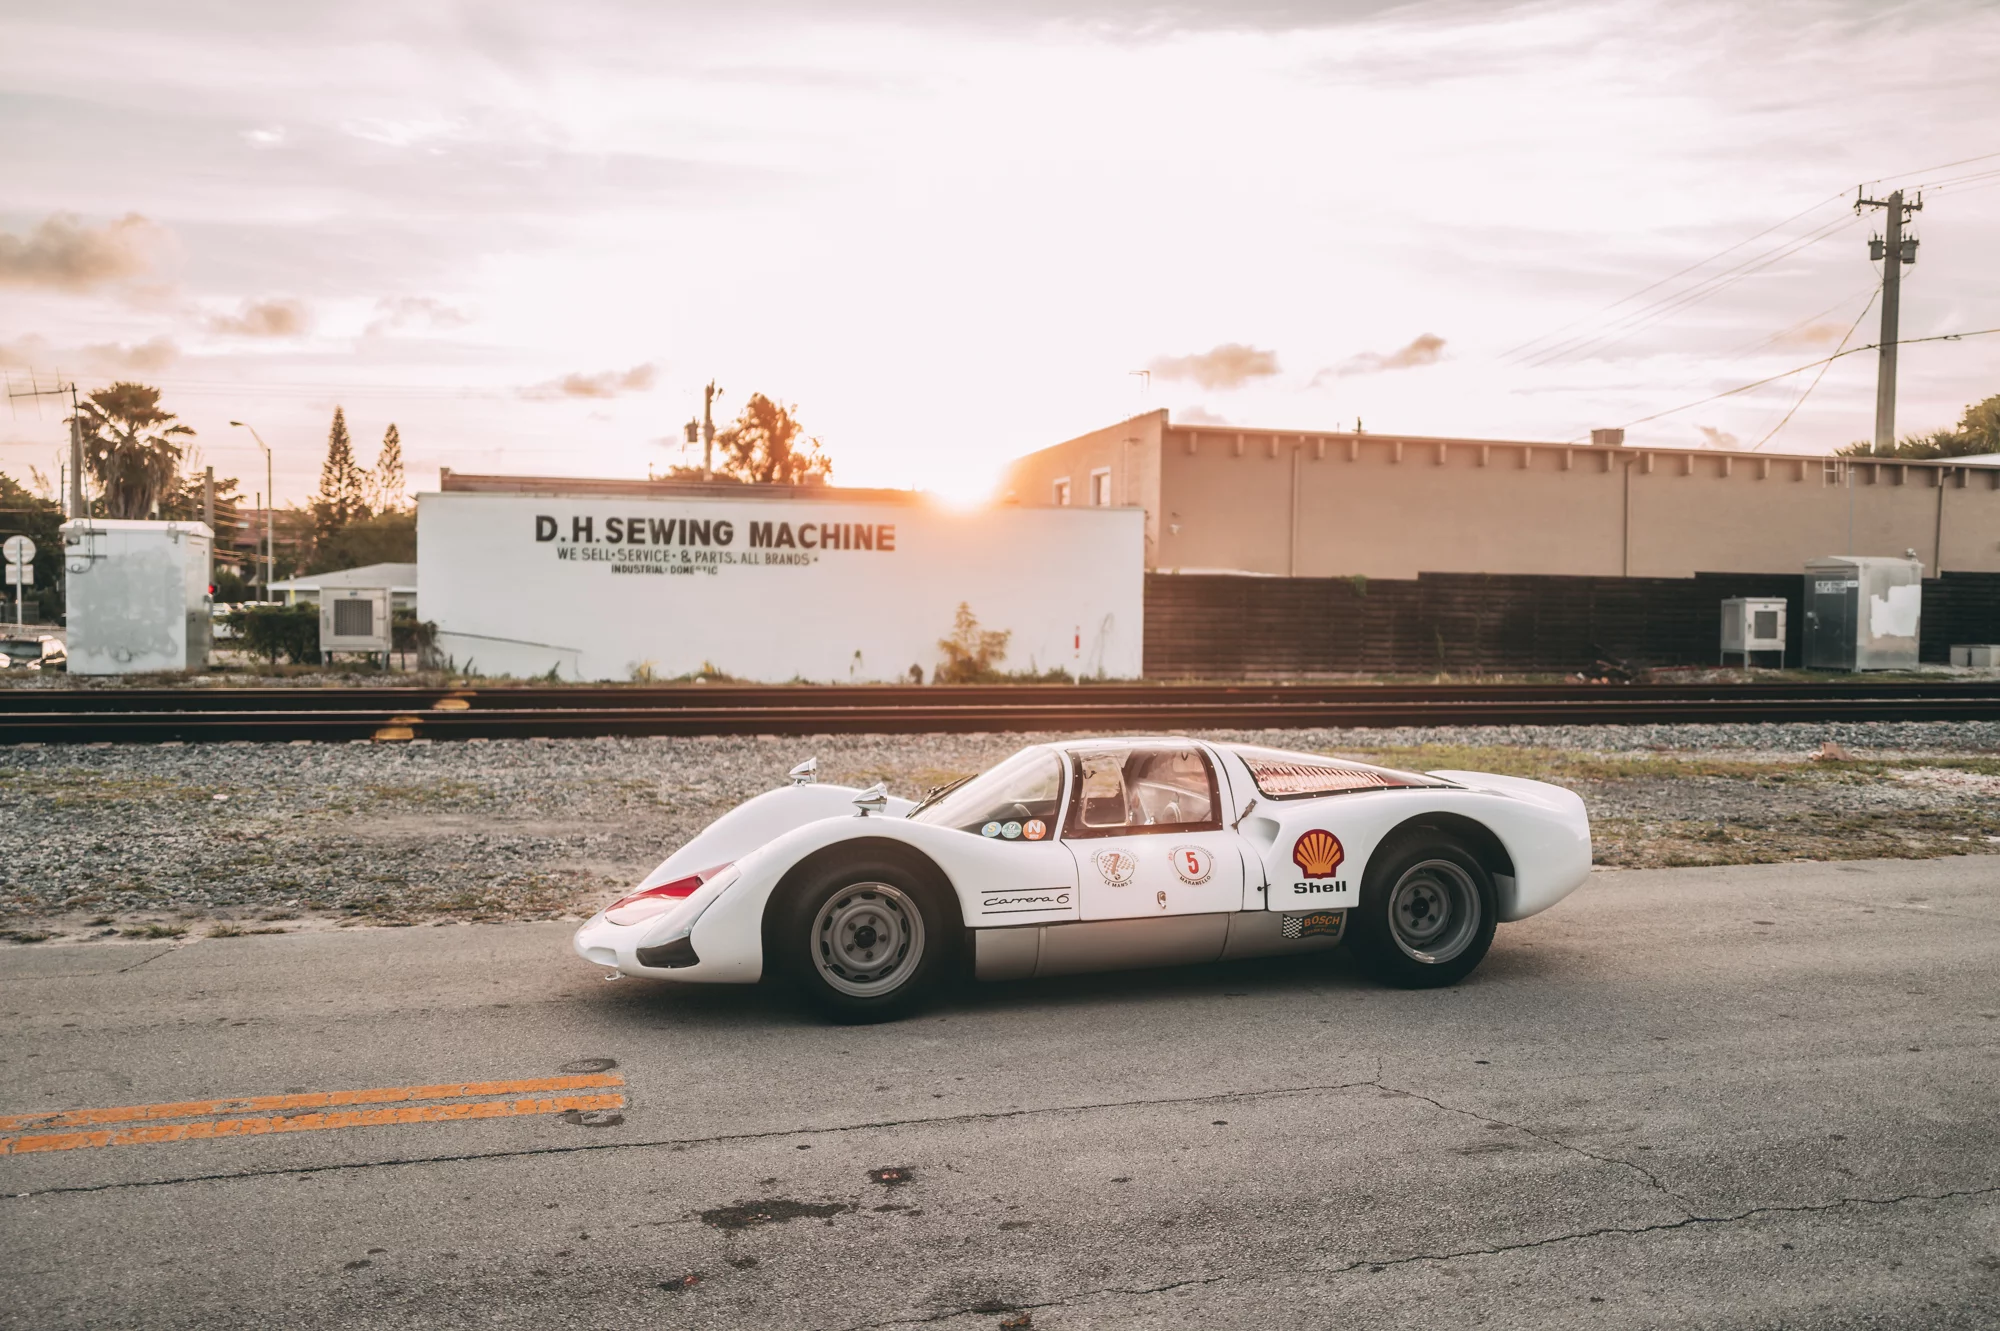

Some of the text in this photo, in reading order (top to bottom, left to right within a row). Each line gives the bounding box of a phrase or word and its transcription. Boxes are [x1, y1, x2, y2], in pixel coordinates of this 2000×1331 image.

[749, 520, 896, 552] MACHINE
[557, 547, 577, 561] WE
[681, 551, 692, 564] &
[740, 553, 760, 566] ALL
[1027, 820, 1042, 834] N
[1108, 853, 1121, 875] 7
[1185, 851, 1200, 875] 5
[1179, 875, 1212, 886] MARANELLO
[1294, 881, 1347, 894] Shell
[1056, 893, 1070, 904] 6
[1304, 915, 1340, 927] BOSCH
